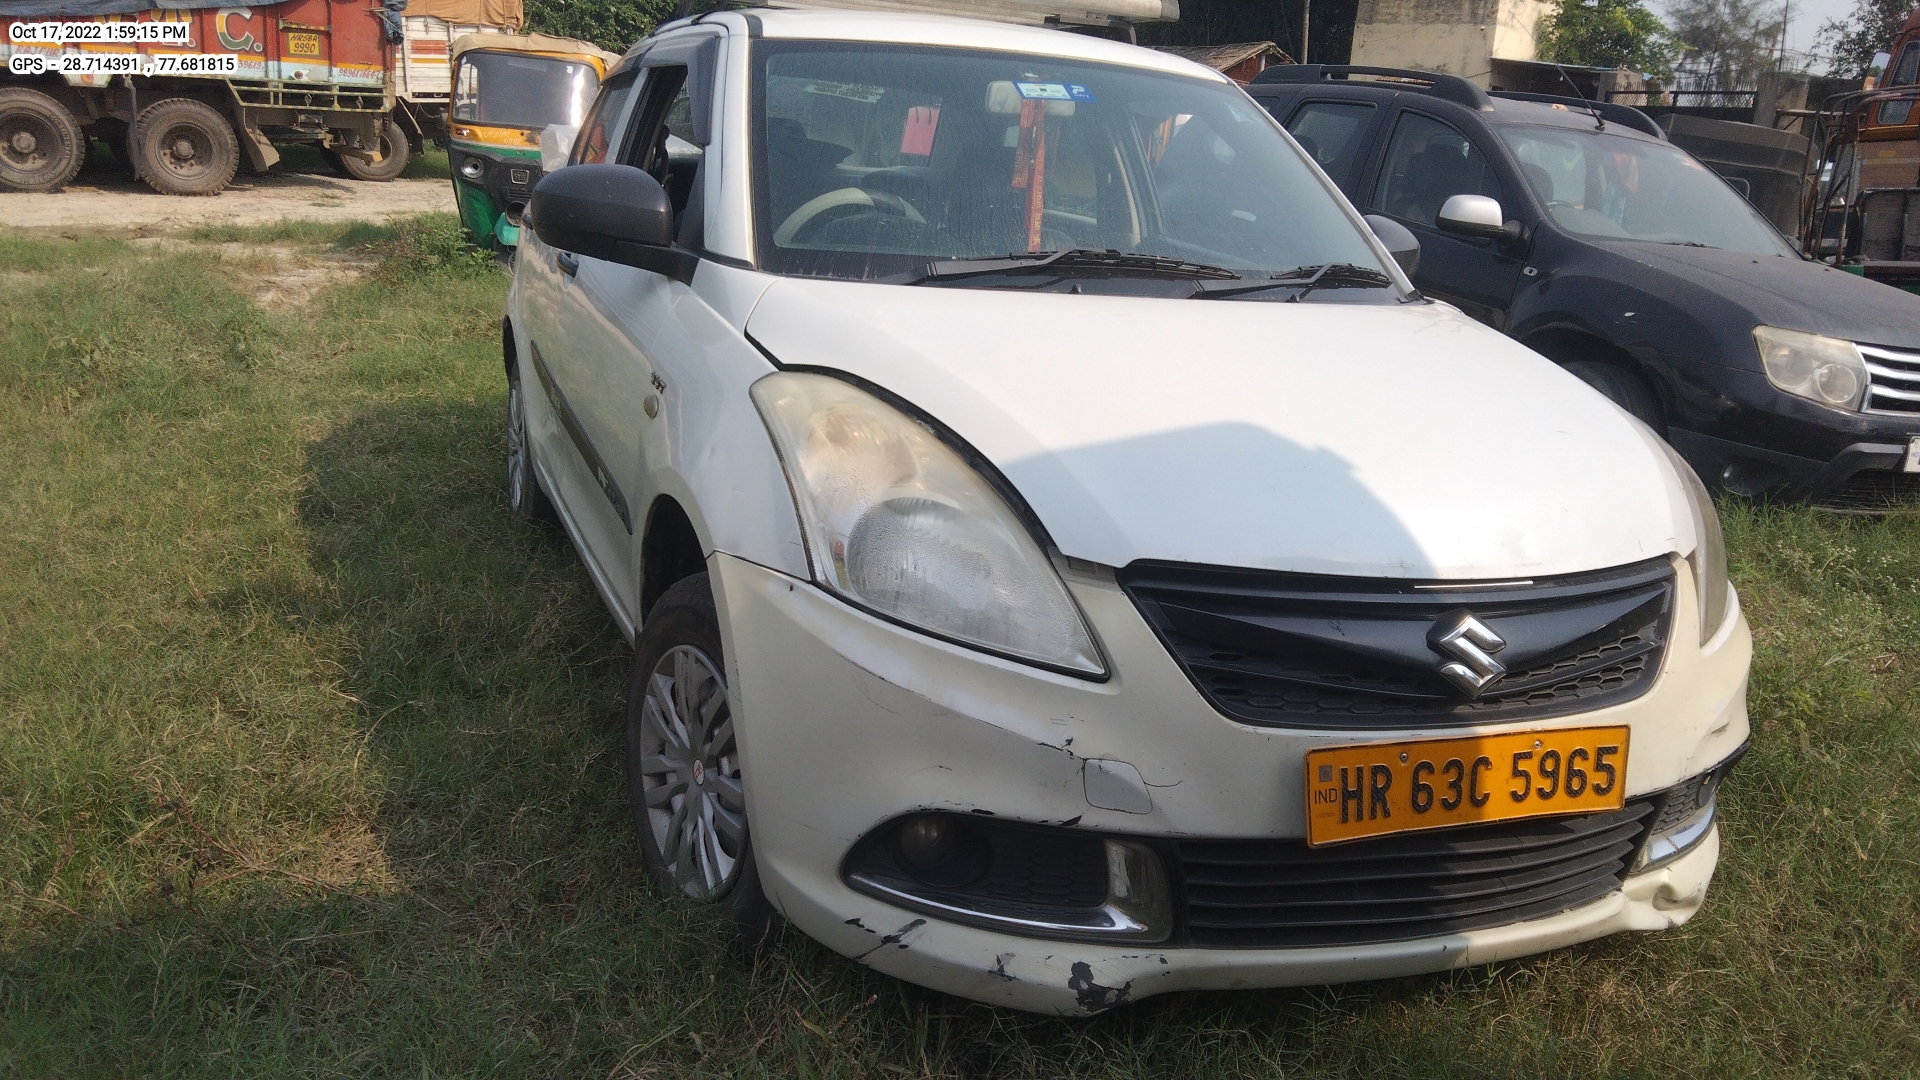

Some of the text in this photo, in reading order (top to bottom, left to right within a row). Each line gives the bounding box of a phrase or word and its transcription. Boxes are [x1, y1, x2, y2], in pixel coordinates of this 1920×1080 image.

[293, 42, 316, 54] 9990
[1339, 745, 1620, 824] HR 63C 5965
[1314, 788, 1338, 805] IND
